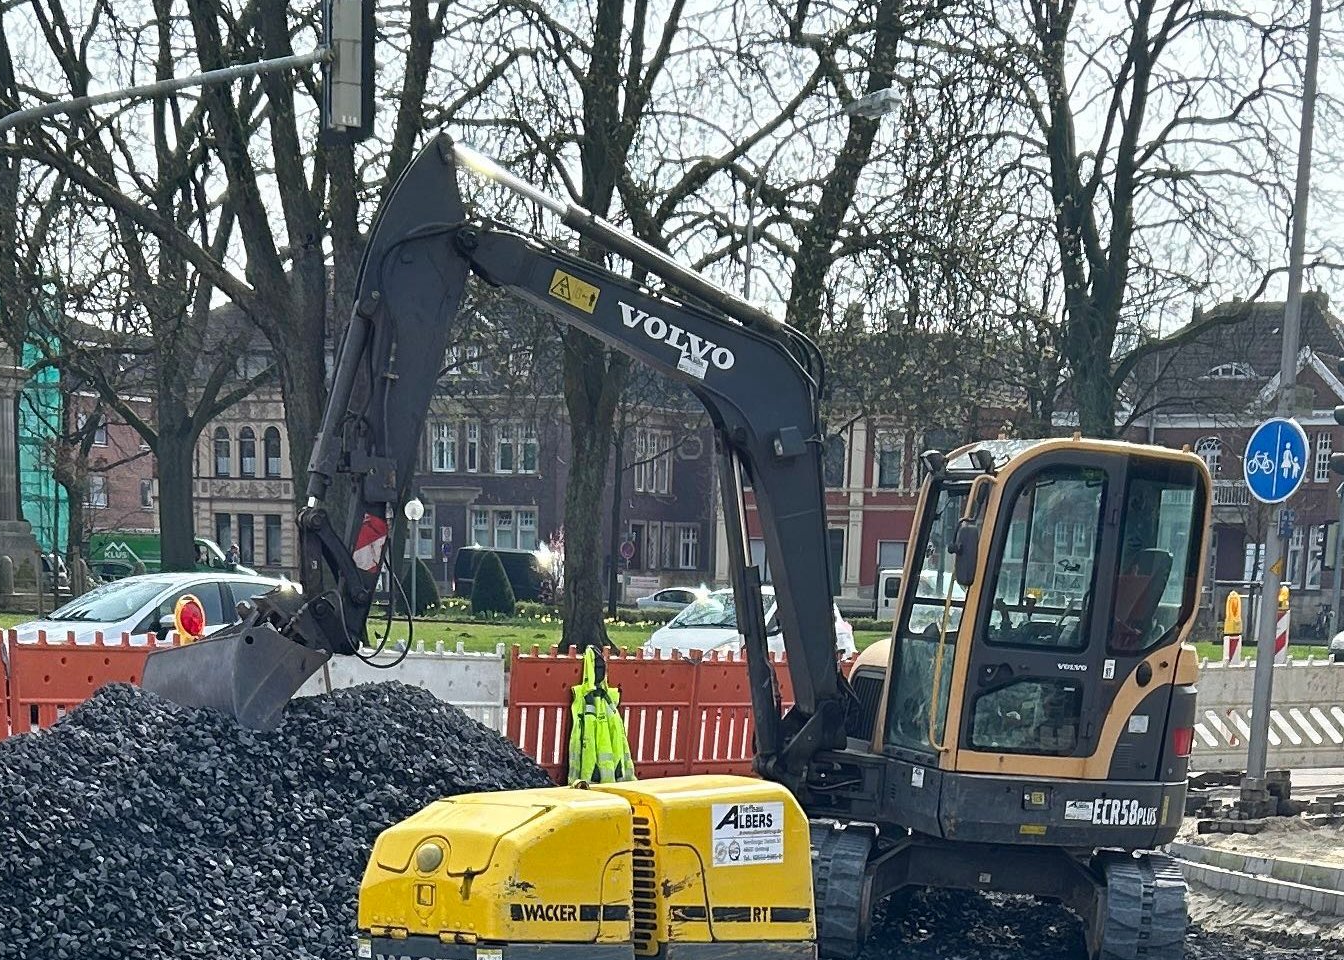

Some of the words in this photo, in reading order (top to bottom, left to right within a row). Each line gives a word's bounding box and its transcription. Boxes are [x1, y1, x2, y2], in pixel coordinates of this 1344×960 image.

[617, 300, 735, 370] VOLVO
[104, 551, 127, 559] KLUS
[1057, 663, 1087, 671] VOLVO
[715, 805, 773, 830] ALBERS
[522, 904, 577, 922] WACKER
[752, 906, 769, 922] RT
